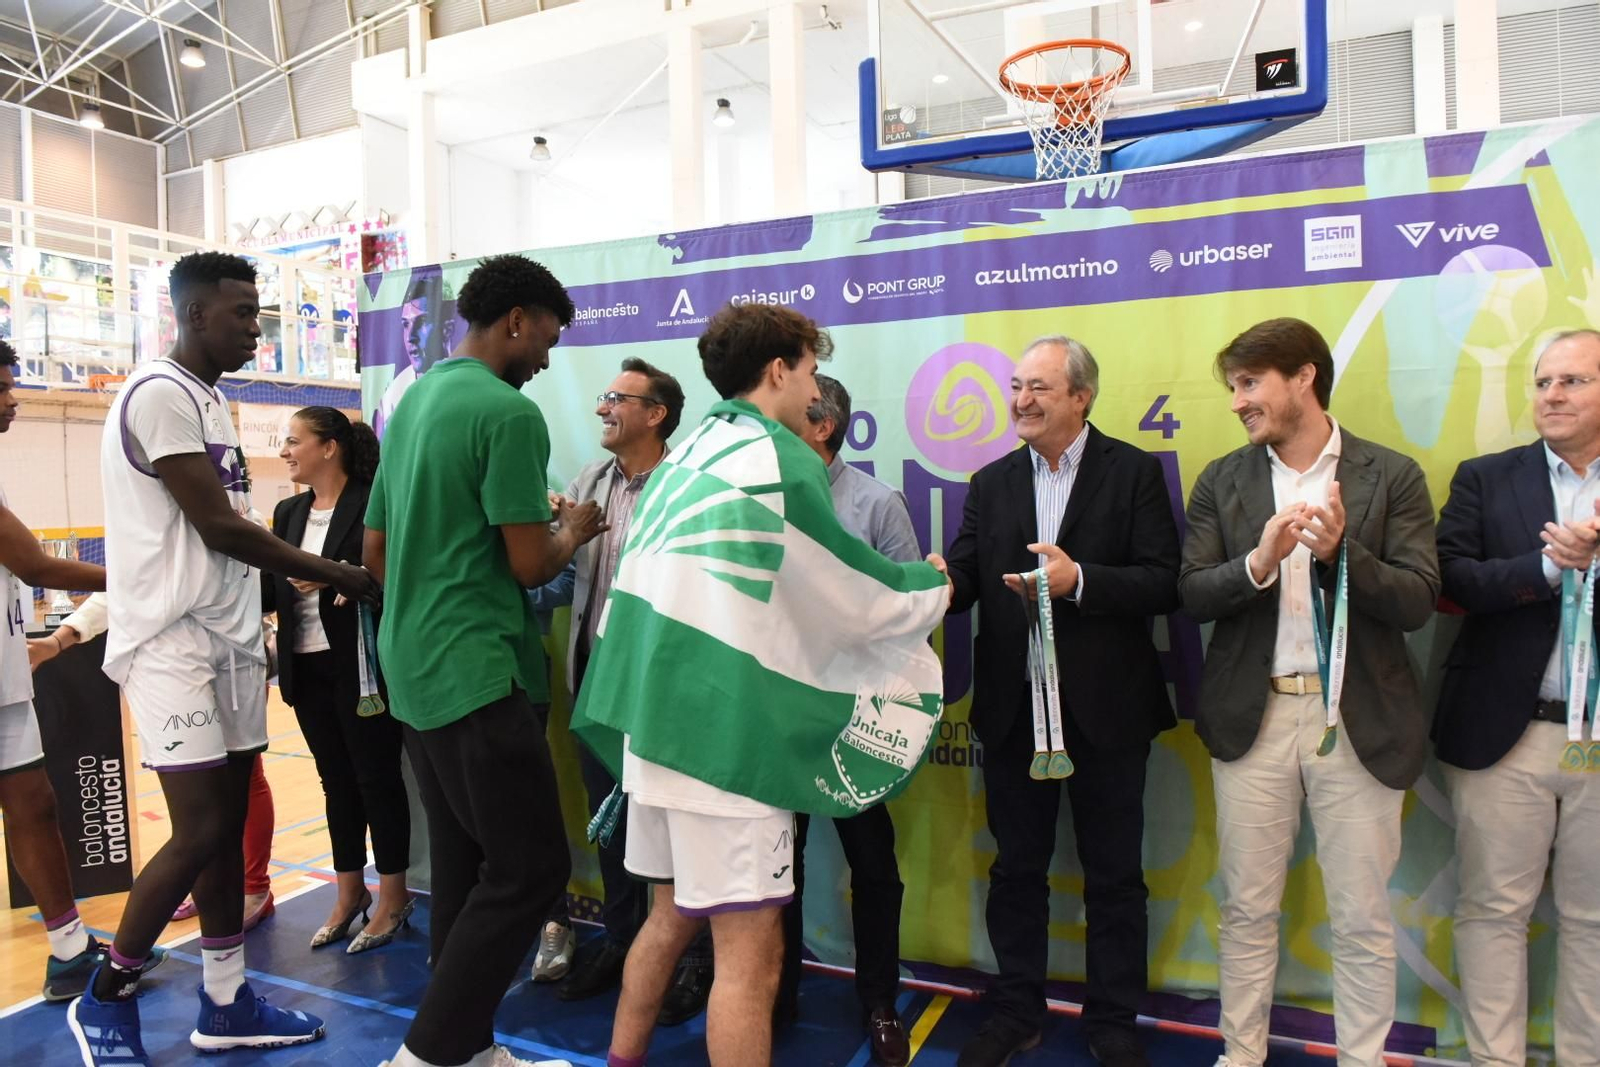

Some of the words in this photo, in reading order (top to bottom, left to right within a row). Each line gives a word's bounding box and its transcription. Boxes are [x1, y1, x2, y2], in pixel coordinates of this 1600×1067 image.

[885, 131, 912, 141] PLATA
[1311, 226, 1355, 242] SGM
[1438, 223, 1500, 243] vive
[1179, 243, 1273, 267] urbaser
[1311, 251, 1356, 261] ambiental
[975, 257, 1118, 286] azulmarino
[867, 280, 905, 295] PONT
[907, 275, 946, 291] GRUP
[1138, 394, 1181, 439] 4
[7, 598, 24, 636] 14
[843, 732, 905, 766] Baloncesto
[75, 755, 105, 868] baloncesto
